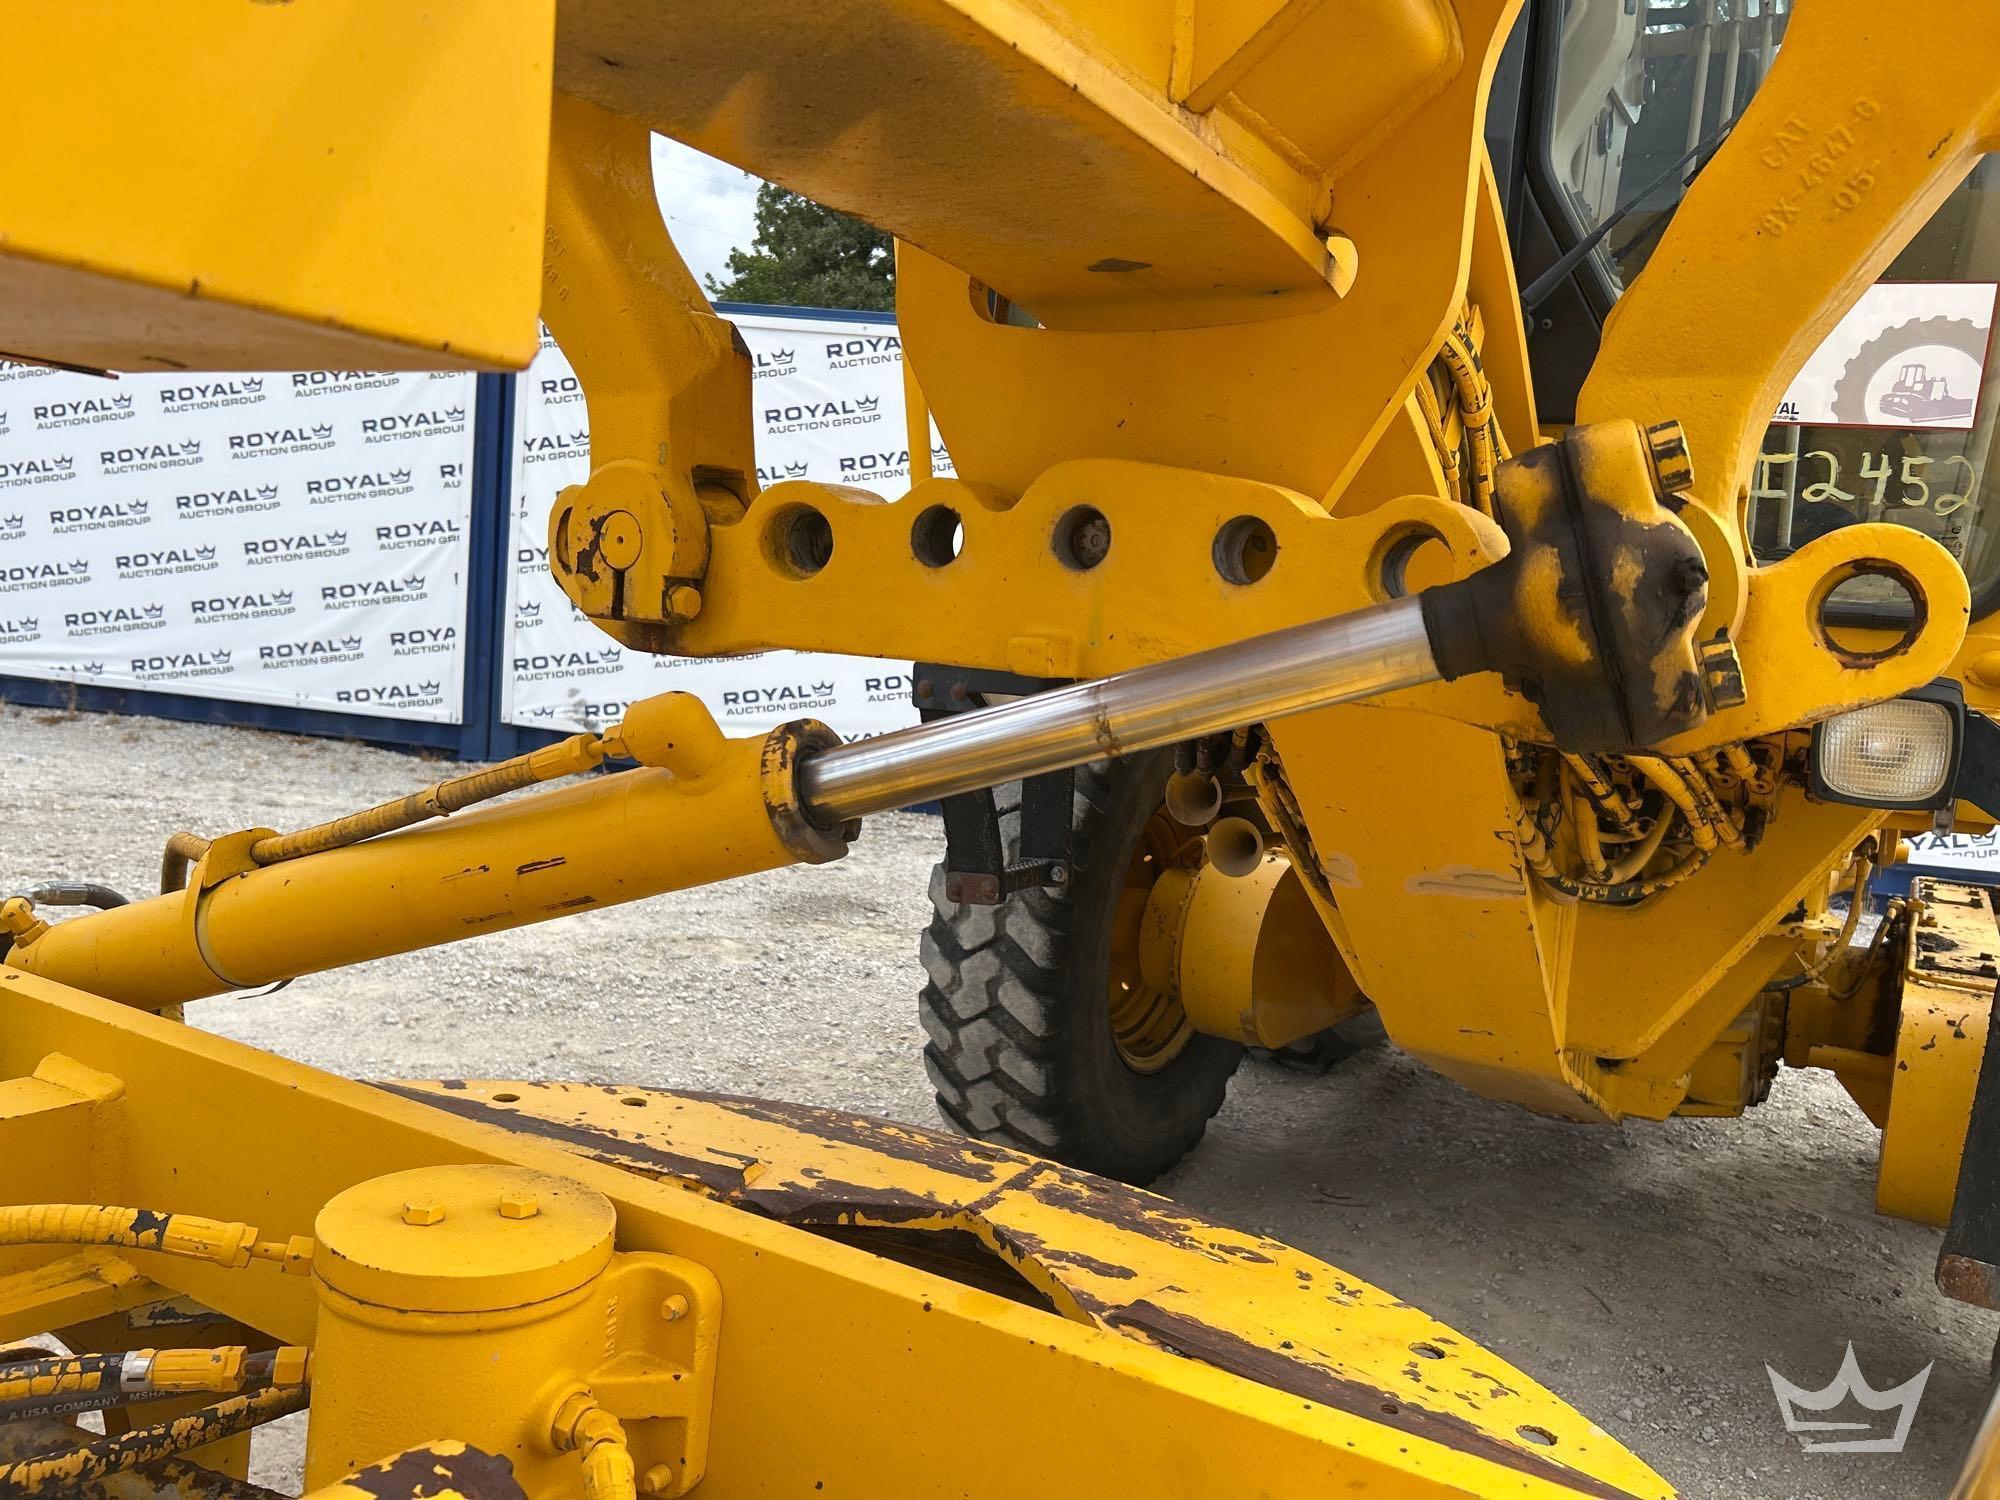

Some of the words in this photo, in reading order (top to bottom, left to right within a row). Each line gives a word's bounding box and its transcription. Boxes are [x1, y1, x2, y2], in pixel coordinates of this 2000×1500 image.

[1761, 112, 1811, 170] CAT
[827, 337, 902, 359] ROYA
[829, 354, 891, 370] AUCTION
[160, 382, 242, 403] ROYAL
[295, 384, 350, 398] AUCTION
[354, 378, 400, 391] GROUP
[34, 398, 112, 420] ROYAL
[163, 400, 219, 414] AUCTION
[221, 395, 266, 407] GROUP
[544, 394, 584, 405] AUCTI
[37, 416, 90, 431] AUCTION
[92, 411, 135, 425] GROUP
[362, 411, 446, 433] ROYAL
[765, 401, 855, 424] ROYAL
[364, 430, 421, 444] AUCTION
[424, 424, 464, 437] GROU
[768, 420, 829, 435] AUCTION
[833, 414, 881, 428] GROUP
[229, 428, 312, 449] ROYAL
[524, 435, 569, 452] YAL
[100, 443, 180, 465] ROYAL
[232, 446, 288, 460] AUCTION
[290, 441, 336, 454] GROUP
[549, 449, 590, 461] GROU
[0, 460, 54, 478] OYAL
[103, 461, 157, 476] AUCTION
[160, 456, 203, 470] GROUP
[840, 451, 910, 471] ROYA
[0, 478, 32, 489] TION
[34, 472, 76, 485] GROUP
[307, 473, 390, 495] ROYAL
[843, 469, 904, 483] AUCTION
[176, 489, 257, 510] ROYAL
[309, 490, 366, 505] AUCTION
[368, 485, 414, 498] GROUP
[50, 503, 128, 525] ROYAL
[179, 506, 234, 520] AUCTION
[236, 501, 281, 514] GROUP
[0, 530, 26, 541] OUP
[53, 521, 106, 536] AUCTION
[108, 516, 151, 530] GROUP
[376, 520, 460, 541] ROYAL
[244, 534, 326, 555] ROYAL
[379, 537, 436, 551] AUCTION
[116, 549, 196, 569] ROYAL
[247, 552, 302, 566] AUCTION
[305, 547, 350, 560] GROUP
[119, 567, 173, 580] AUCTION
[175, 561, 218, 575] GROUP
[518, 564, 549, 574] CTIO
[49, 576, 91, 589] GROUP
[321, 579, 404, 601] ROYAL
[191, 594, 272, 614] ROYAL
[324, 597, 380, 611] AUCTION
[382, 592, 427, 605] GROUP
[65, 607, 143, 627] ROYAL
[194, 611, 249, 624] AUCTION
[251, 606, 295, 619] GROUP
[515, 619, 543, 629] OUP
[68, 624, 121, 638] AUCTION
[123, 619, 166, 633] GROUP
[390, 628, 456, 647] ROYA
[260, 639, 341, 660] ROYAL
[393, 643, 449, 657] AUCTION
[132, 653, 210, 672] ROYAL
[262, 656, 318, 670] AUCTION
[320, 652, 364, 665] GROUP
[514, 652, 600, 671] ROYAL
[654, 657, 713, 669] AUCTION
[136, 670, 188, 681] AUCTION
[191, 665, 234, 678] GROUP
[516, 671, 575, 682] AUCTION
[577, 665, 624, 678] GROUP
[866, 675, 914, 692] ROY
[337, 685, 419, 702] ROYAL
[398, 696, 443, 709] GROUP
[723, 685, 811, 705] ROYAL
[868, 691, 913, 703] AUCTI
[726, 703, 786, 717] AUCTION
[789, 698, 836, 711] GROUP
[1908, 834, 1969, 850] YAL
[8, 1411, 18, 1421] A
[22, 1408, 50, 1419] USA
[53, 1395, 120, 1414] COMPANY
[129, 1390, 166, 1401] MSHA
